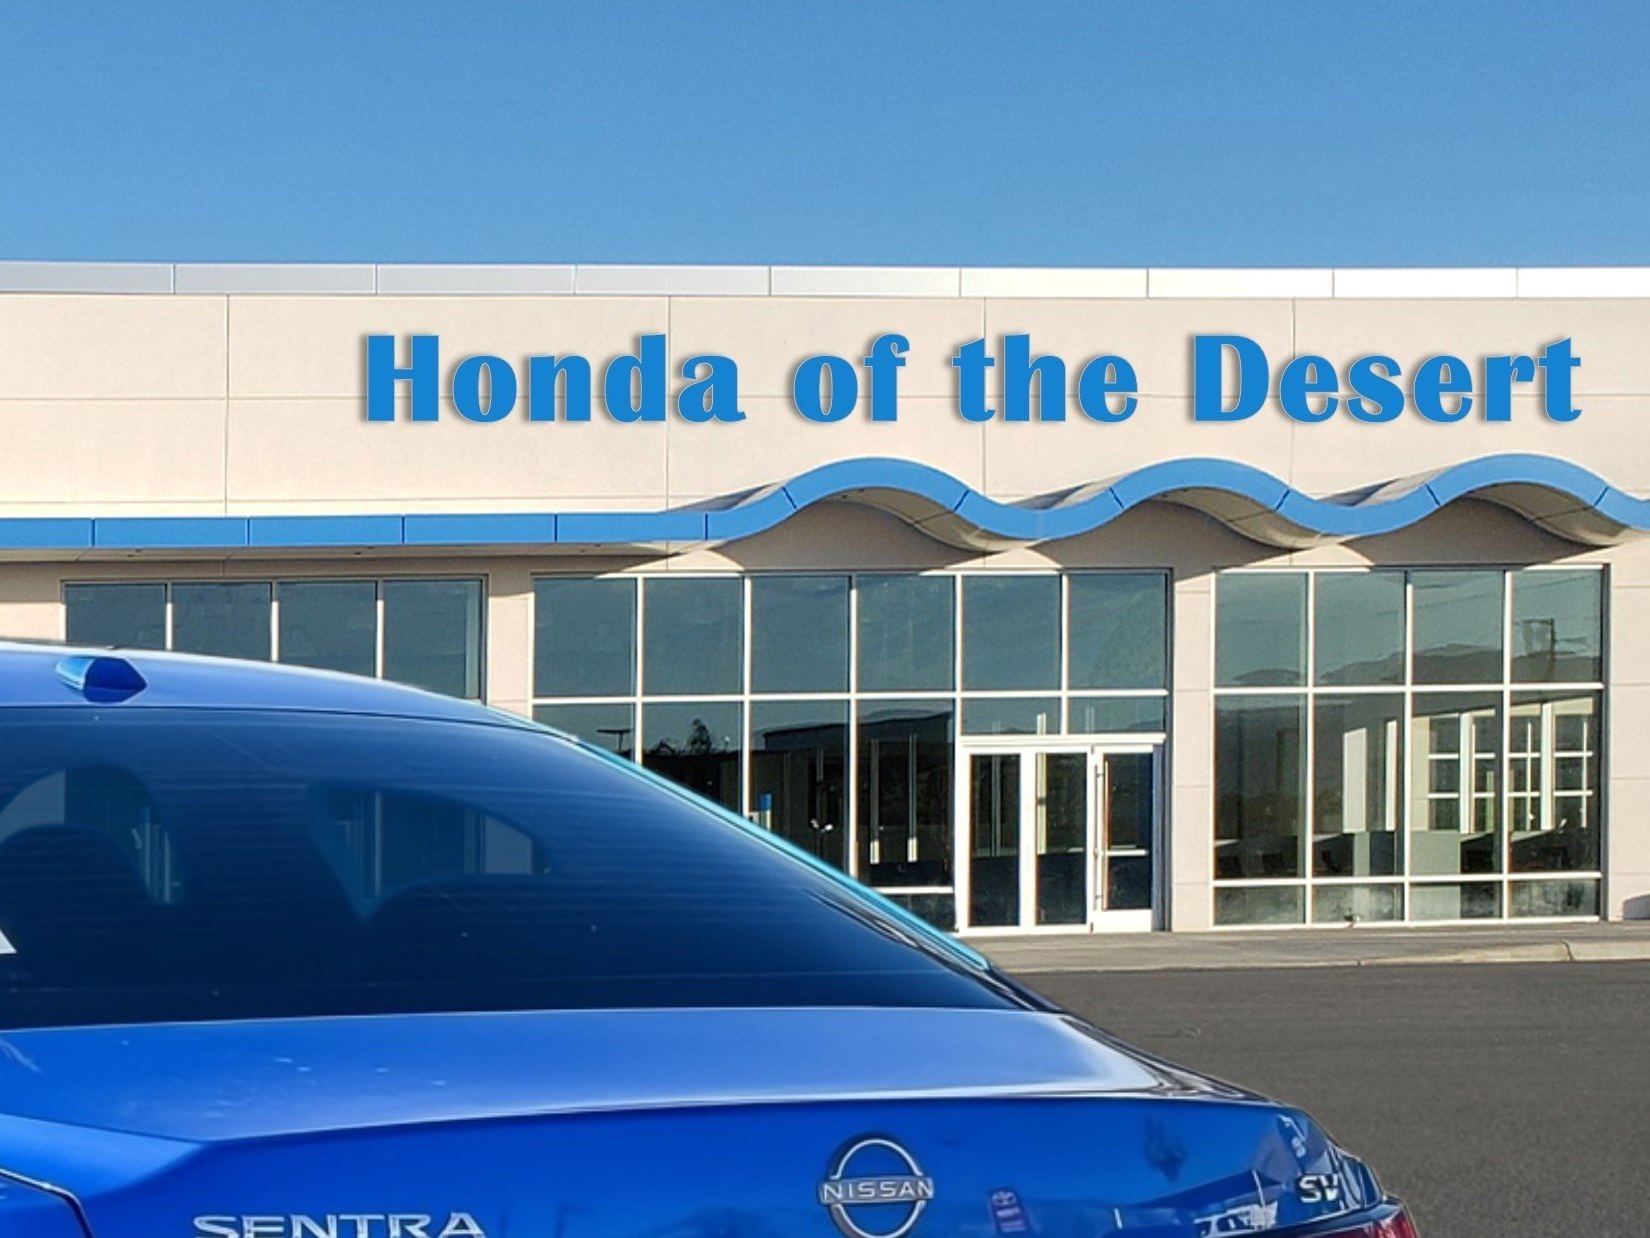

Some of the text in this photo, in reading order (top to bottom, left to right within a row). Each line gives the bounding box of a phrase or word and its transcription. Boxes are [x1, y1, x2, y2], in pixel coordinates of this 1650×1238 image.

[366, 333, 1583, 423] Honda of the Desert
[823, 1181, 934, 1200] NISSAN
[1299, 1174, 1339, 1203] SV
